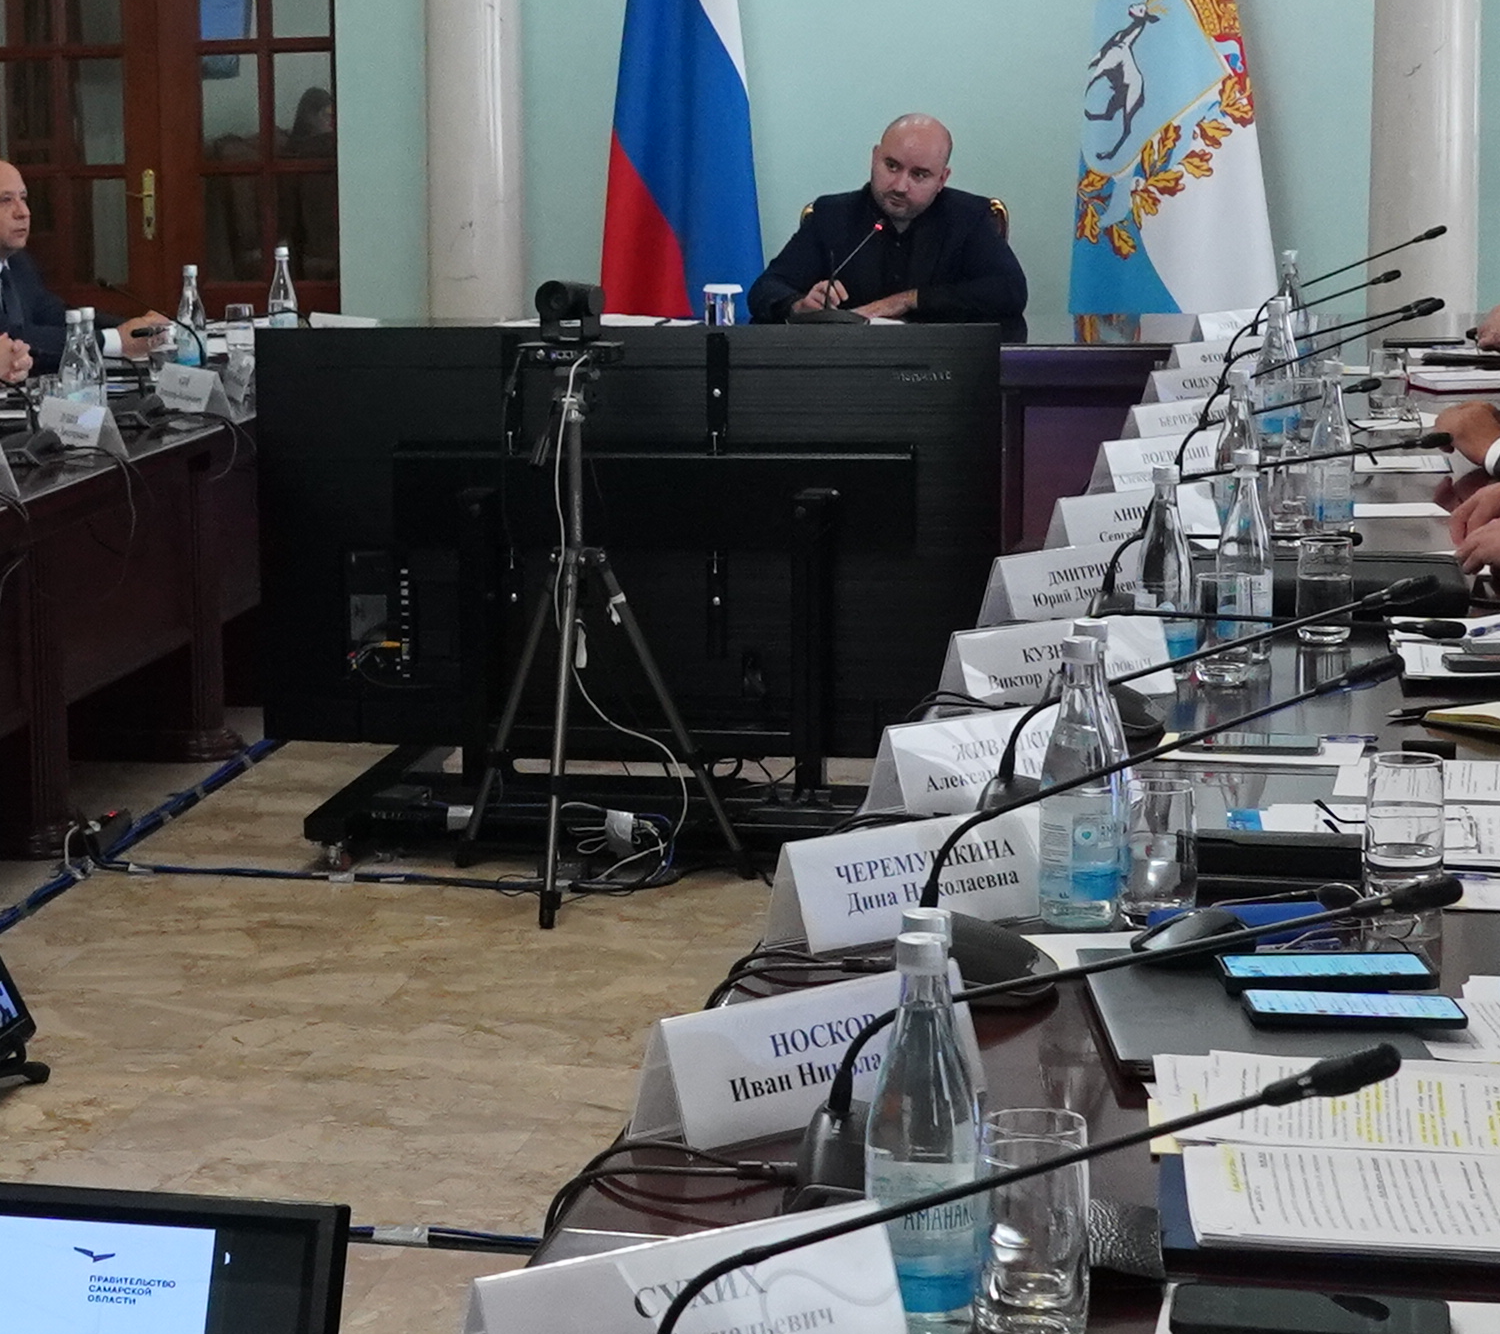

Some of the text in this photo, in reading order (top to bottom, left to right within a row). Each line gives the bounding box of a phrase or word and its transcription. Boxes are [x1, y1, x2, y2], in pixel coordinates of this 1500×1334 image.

[1141, 445, 1211, 465] ВОЕВДИН
[1048, 560, 1124, 587] ДМИТРИВ
[1032, 588, 1073, 609] Юрий
[988, 672, 1043, 690] Виктор
[848, 870, 1020, 917] Дина Нколаевна
[729, 1076, 793, 1103] Иван
[88, 1284, 152, 1296] САМАРСКОЙ
[89, 1275, 176, 1289] ПРАВИТЕЛЬСТВО
[87, 1294, 136, 1305] ОБЛАСТИ
